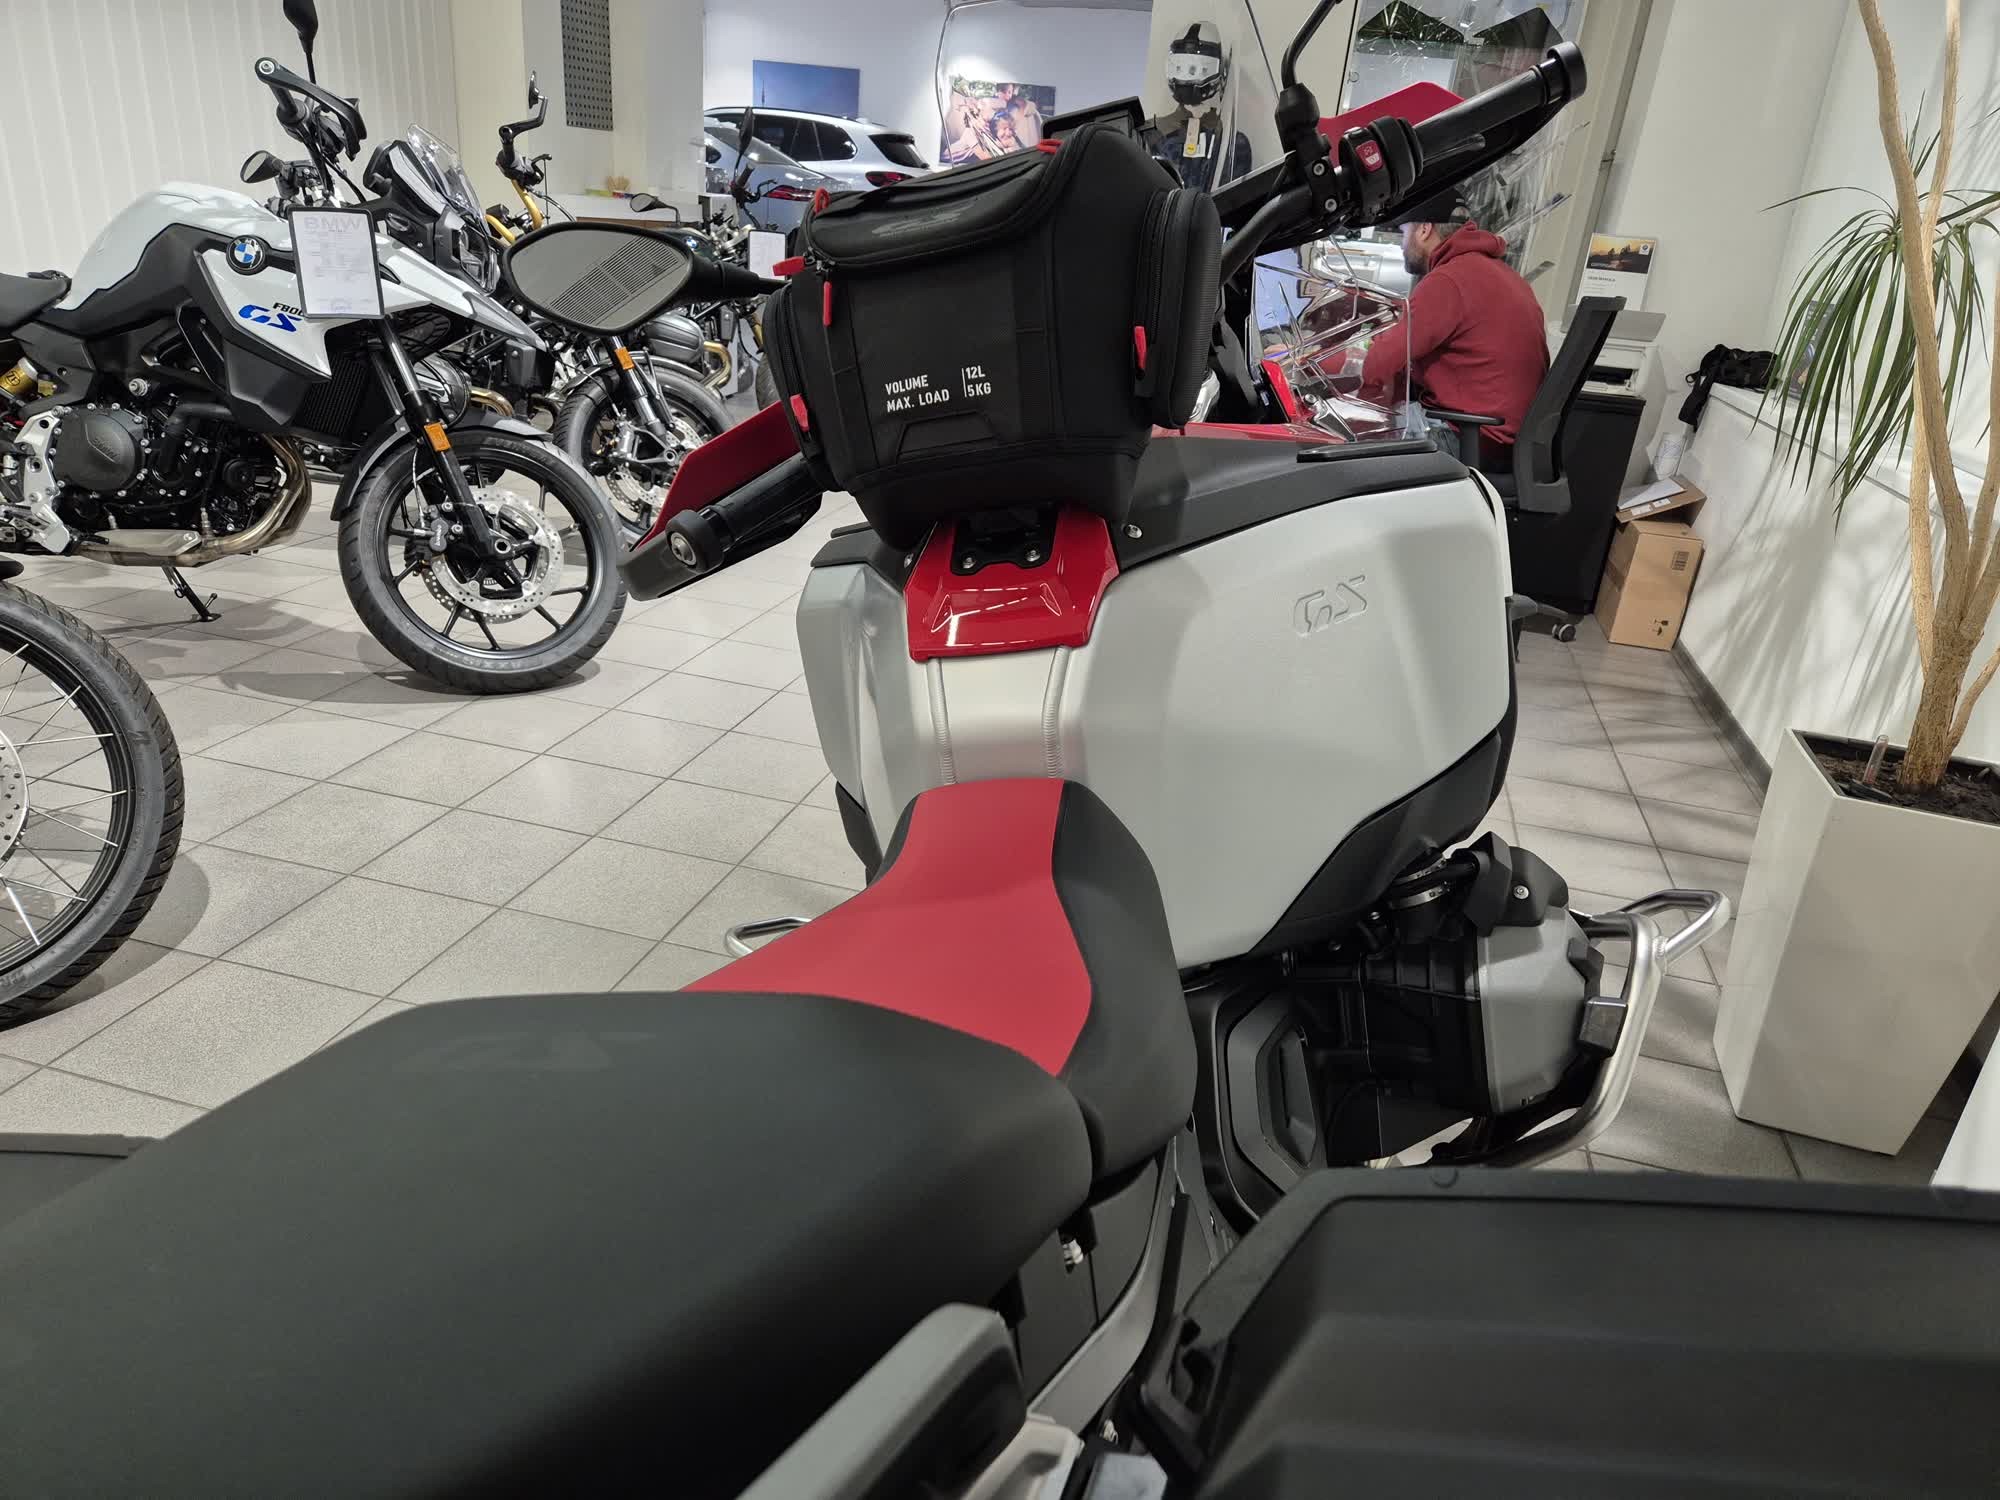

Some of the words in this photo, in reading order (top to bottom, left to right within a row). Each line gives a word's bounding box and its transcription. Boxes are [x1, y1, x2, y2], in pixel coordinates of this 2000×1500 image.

[238, 304, 303, 332] GS
[885, 374, 929, 395] VOLUME
[965, 365, 986, 379] 12L
[886, 396, 915, 413] MAX.
[918, 388, 950, 406] LOAD
[967, 382, 992, 397] 5KG
[1292, 574, 1368, 636] GS
